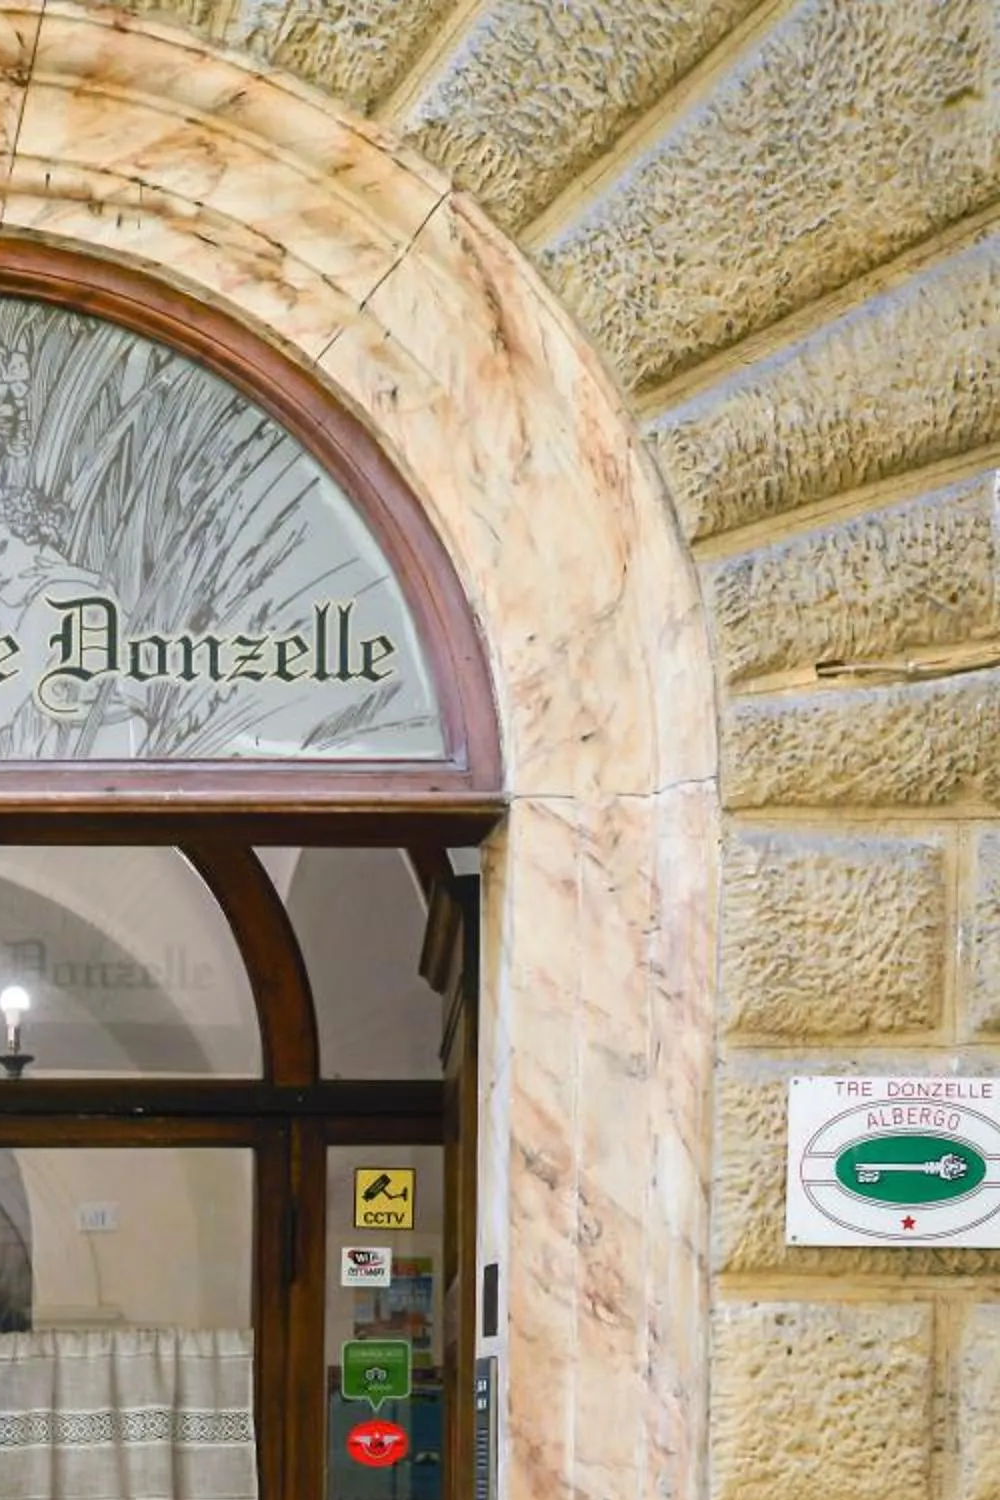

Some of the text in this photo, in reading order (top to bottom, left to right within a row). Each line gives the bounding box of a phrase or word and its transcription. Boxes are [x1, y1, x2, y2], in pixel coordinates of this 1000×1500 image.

[38, 596, 395, 712] Donzelle
[834, 1081, 993, 1099] TRE DONZELLE
[867, 1107, 961, 1131] ALBERGO
[363, 1211, 405, 1224] CCTV
